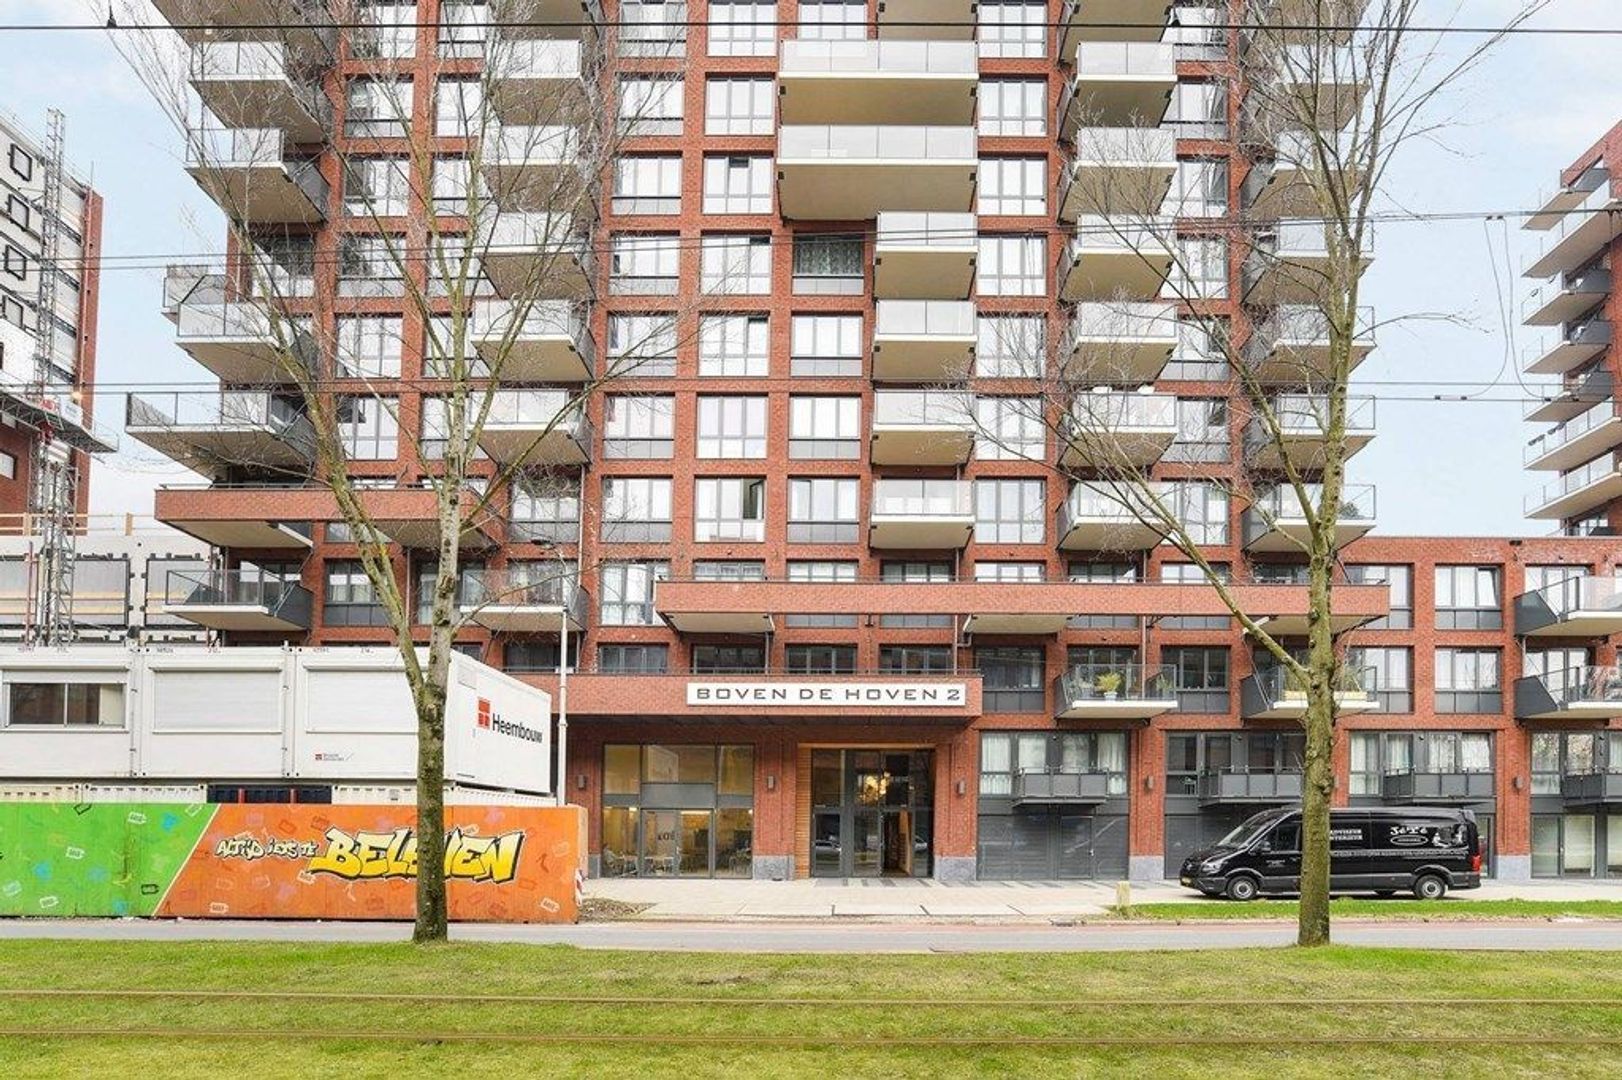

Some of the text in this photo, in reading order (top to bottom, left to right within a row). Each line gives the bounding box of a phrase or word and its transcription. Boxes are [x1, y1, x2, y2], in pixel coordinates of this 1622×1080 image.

[696, 688, 960, 700] BOVEN DE HOVEN 2
